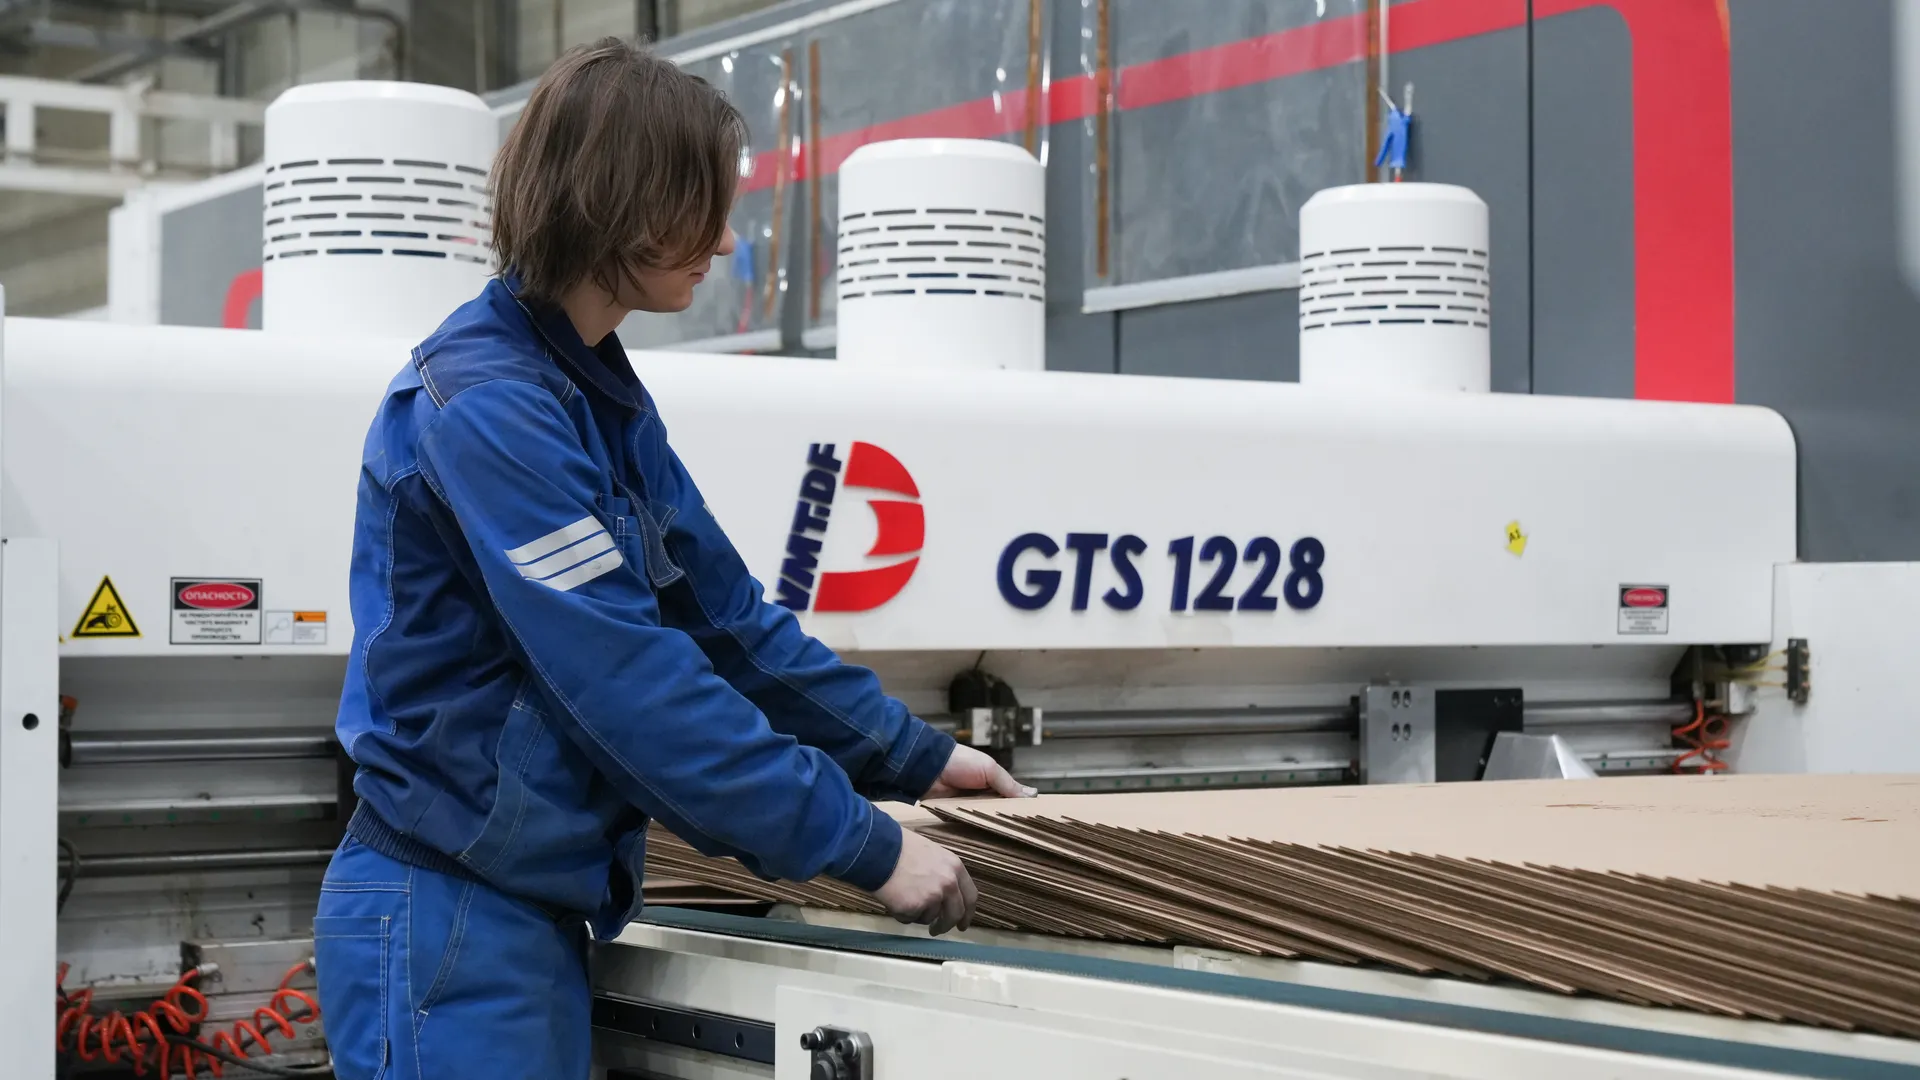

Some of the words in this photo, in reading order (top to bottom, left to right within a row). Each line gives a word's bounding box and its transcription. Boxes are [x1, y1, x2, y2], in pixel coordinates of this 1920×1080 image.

[997, 532, 1148, 612] GTS
[1168, 535, 1325, 613] 1228
[184, 591, 249, 601] ОПАСНОСТЬ
